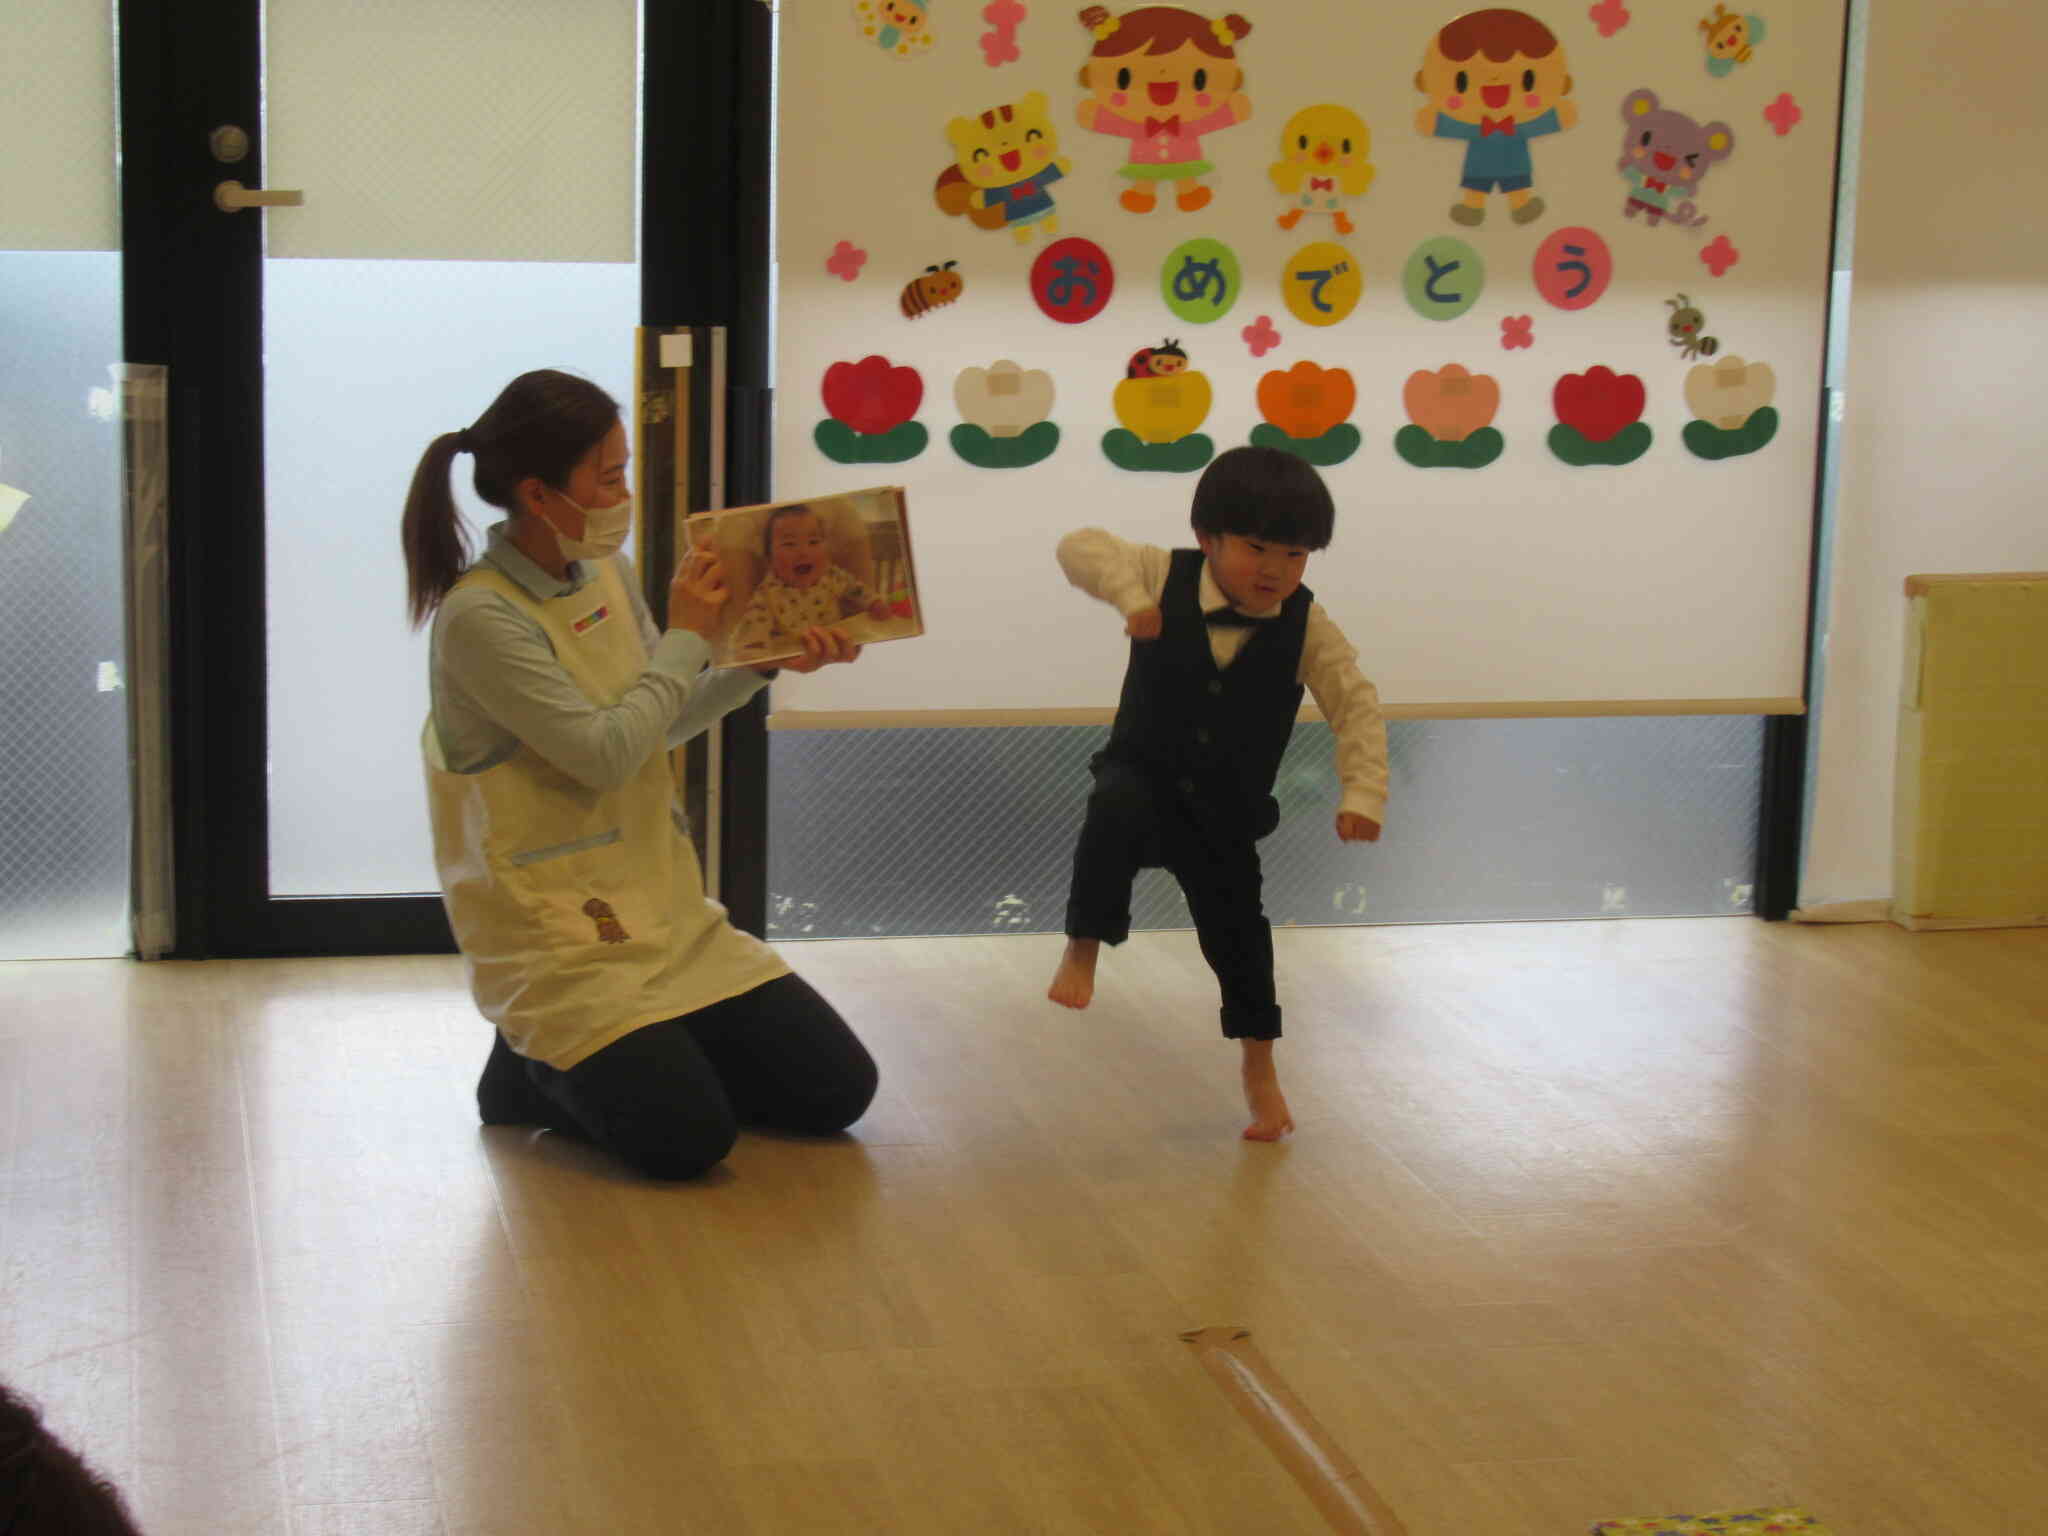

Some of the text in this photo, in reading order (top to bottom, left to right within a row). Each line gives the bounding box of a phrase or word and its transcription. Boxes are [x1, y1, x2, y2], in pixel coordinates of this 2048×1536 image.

[1047, 244, 1591, 312] おめでとう
